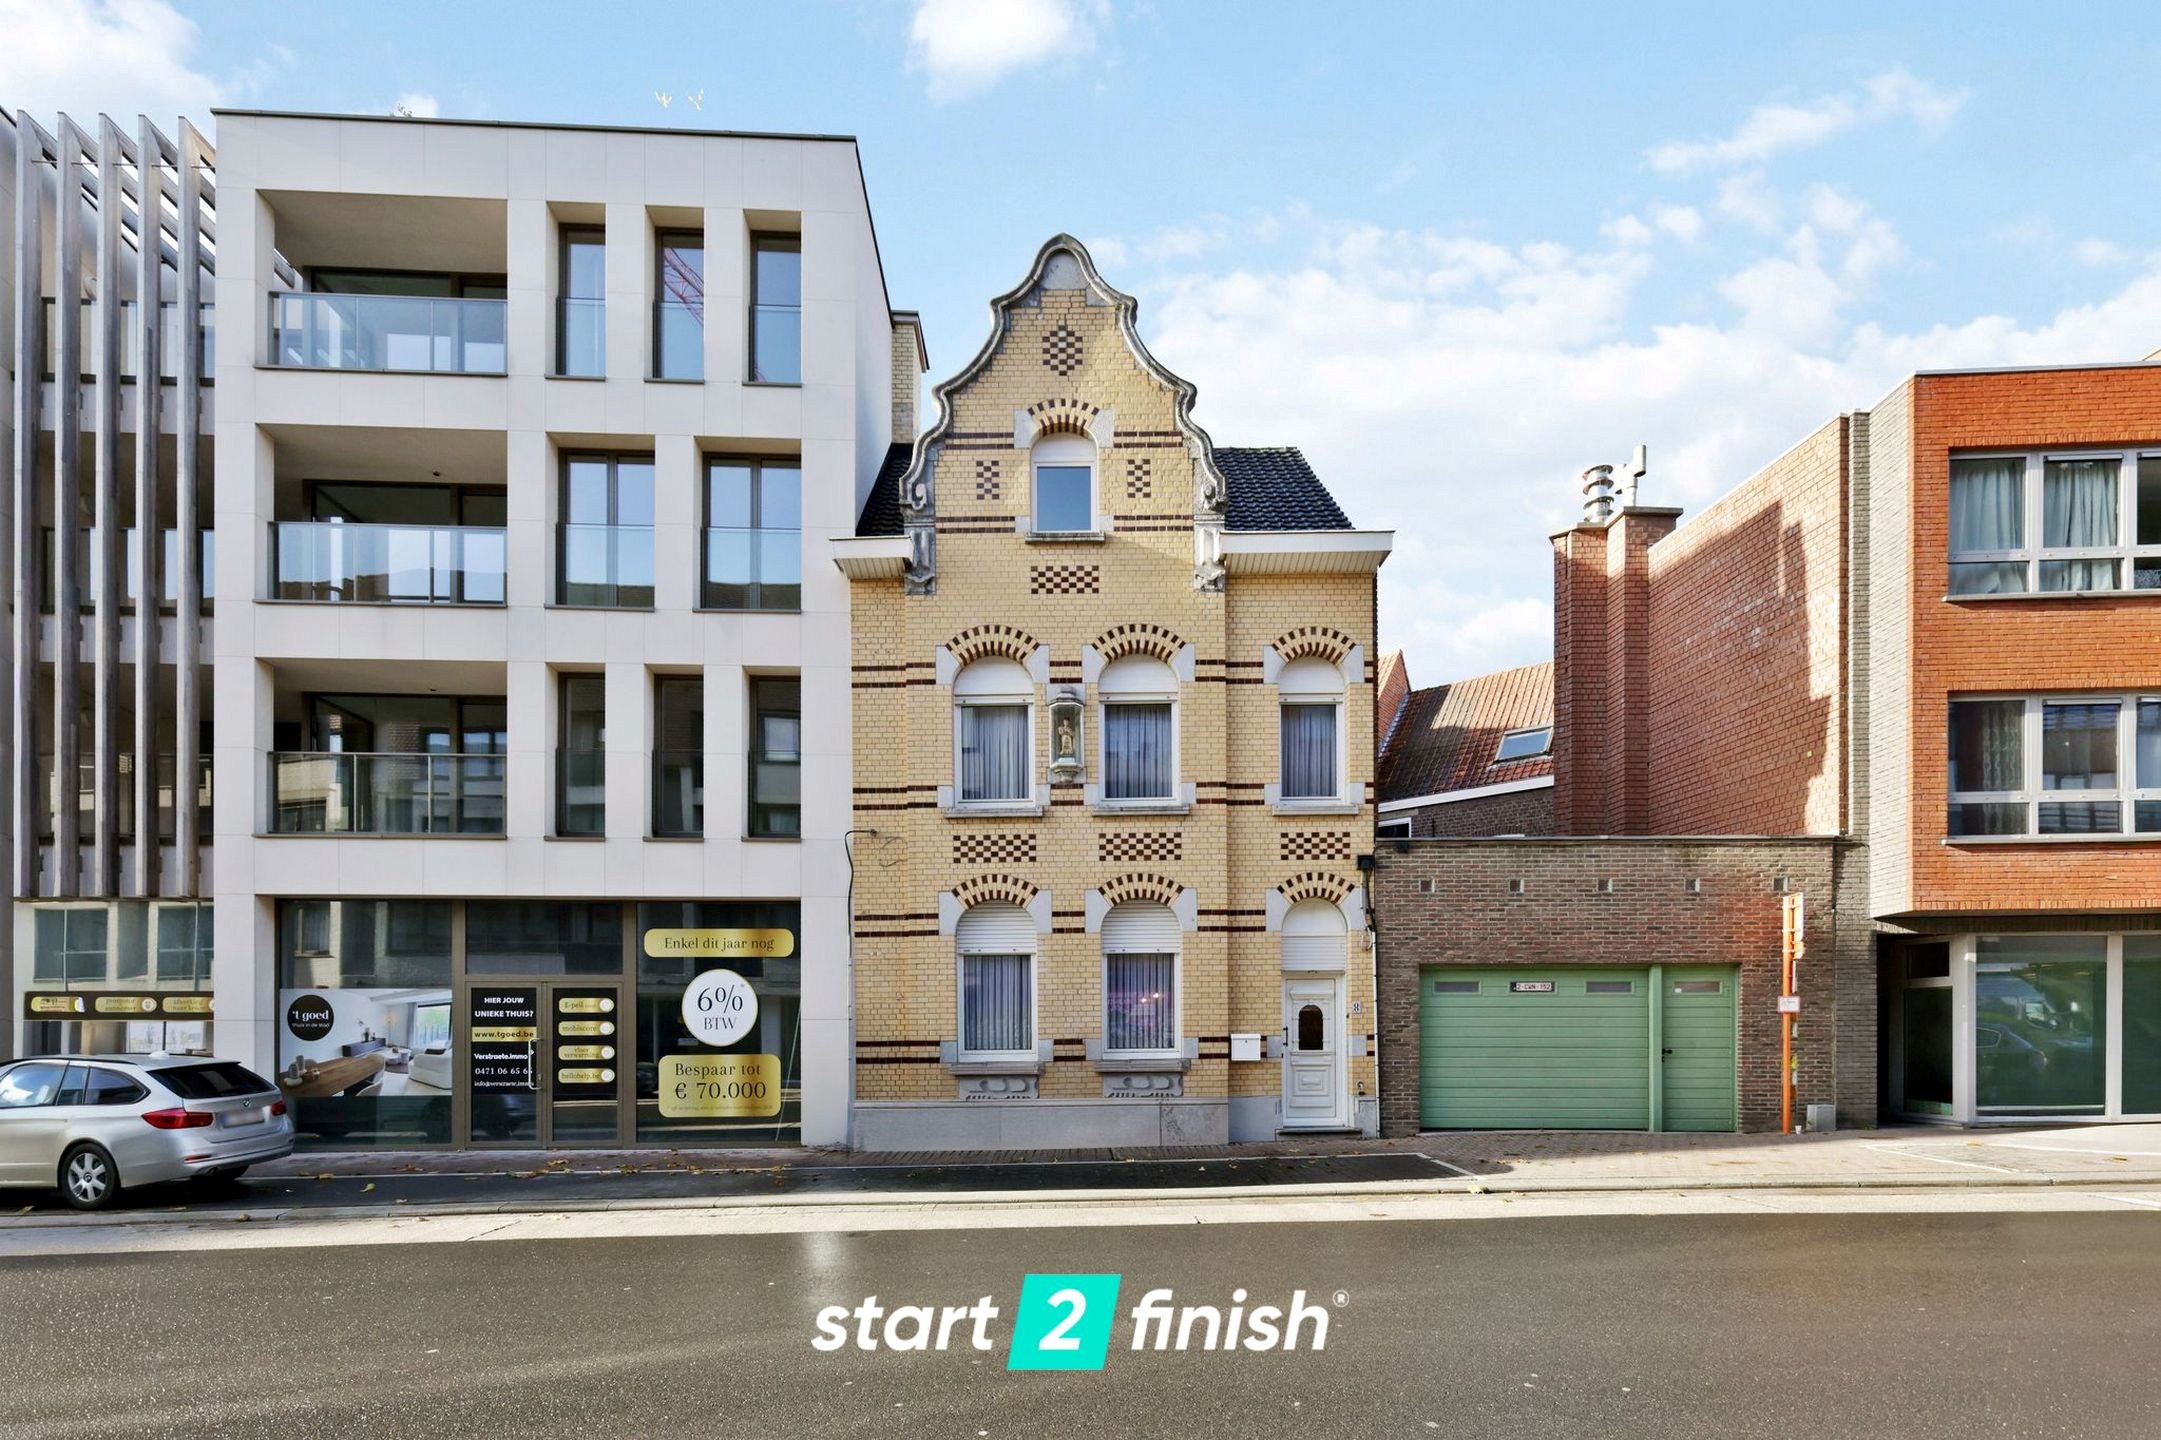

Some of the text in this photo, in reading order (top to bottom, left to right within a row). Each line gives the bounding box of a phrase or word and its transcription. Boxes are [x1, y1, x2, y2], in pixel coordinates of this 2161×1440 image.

[664, 937, 775, 952] Enkel dit jaar nog
[697, 984, 743, 1014] 6%
[302, 1010, 329, 1022] goed
[704, 1017, 737, 1030] BTW
[475, 1067, 495, 1075] 0471
[497, 1067, 508, 1075] 06
[510, 1067, 520, 1075] 65
[675, 1063, 761, 1079] Bespaar tot
[675, 1082, 767, 1100] € 70.000
